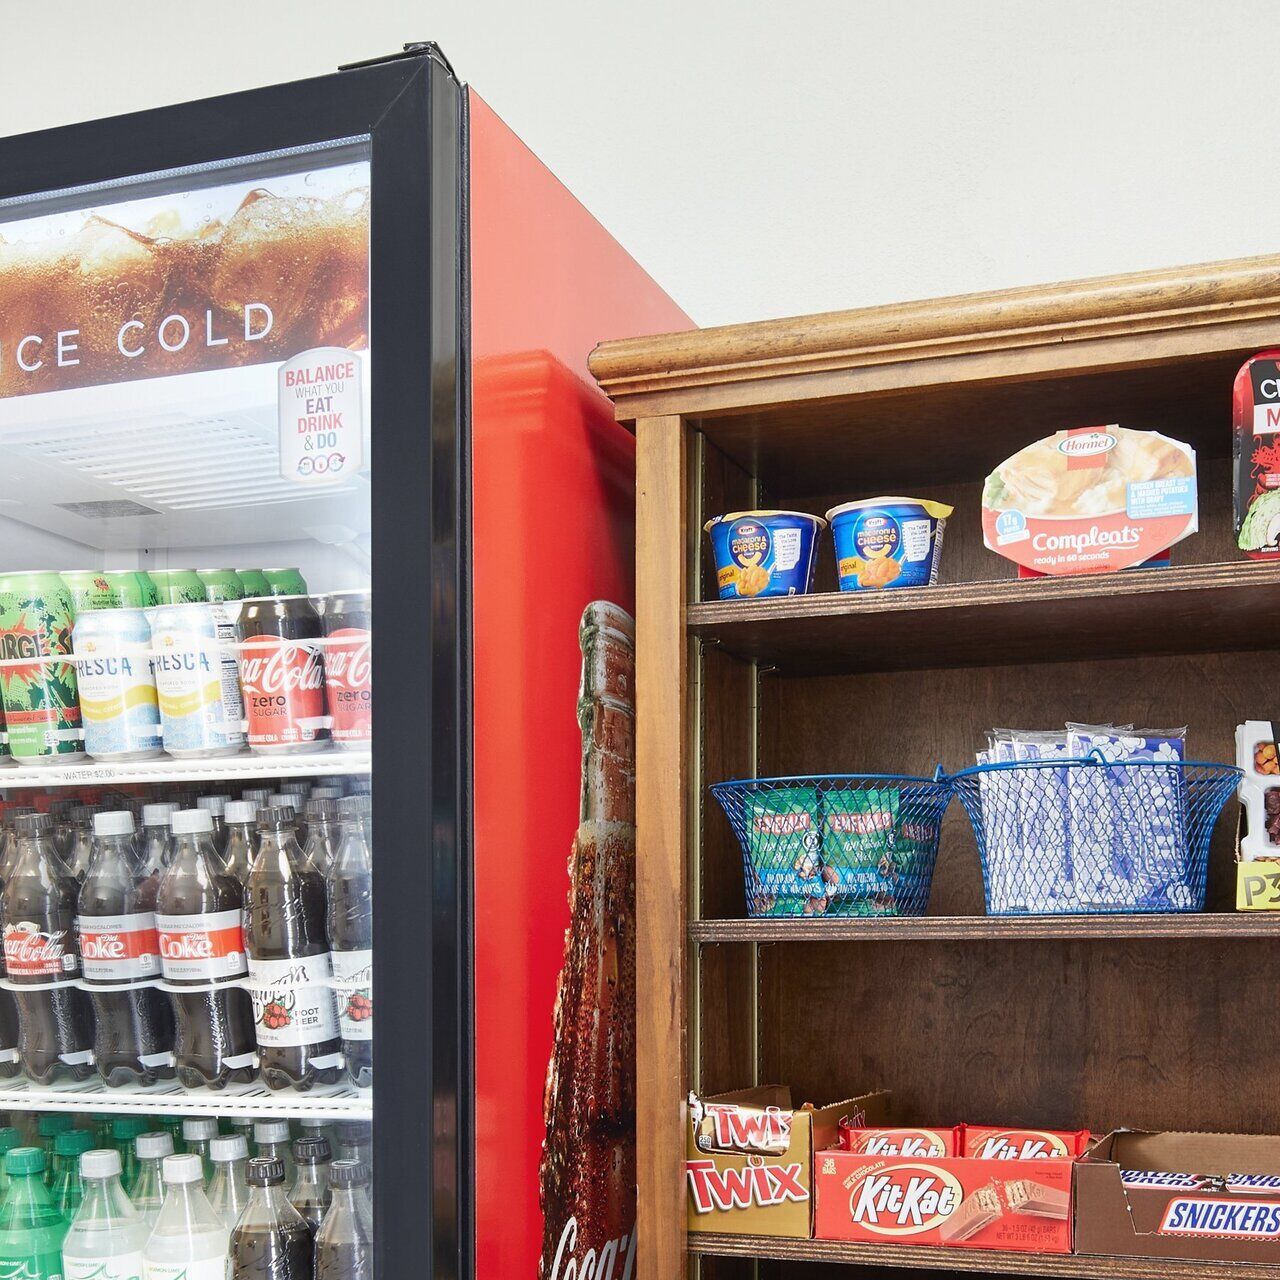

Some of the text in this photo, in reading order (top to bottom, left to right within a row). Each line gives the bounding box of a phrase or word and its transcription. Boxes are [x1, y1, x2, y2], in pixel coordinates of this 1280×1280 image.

[118, 303, 274, 358] COLD
[285, 362, 354, 387] BALANCE
[295, 383, 344, 399] WHAT YOU
[306, 396, 332, 415] EAT
[298, 413, 343, 434] DRINK
[317, 432, 336, 449] DO
[1067, 436, 1109, 450] Hormel
[1032, 526, 1140, 552] Compleats
[1034, 552, 1109, 564] ready in 60 seconds
[252, 694, 286, 708] zero
[254, 708, 287, 717] SUGAR
[64, 770, 92, 780] WATER
[160, 934, 213, 958] Coke
